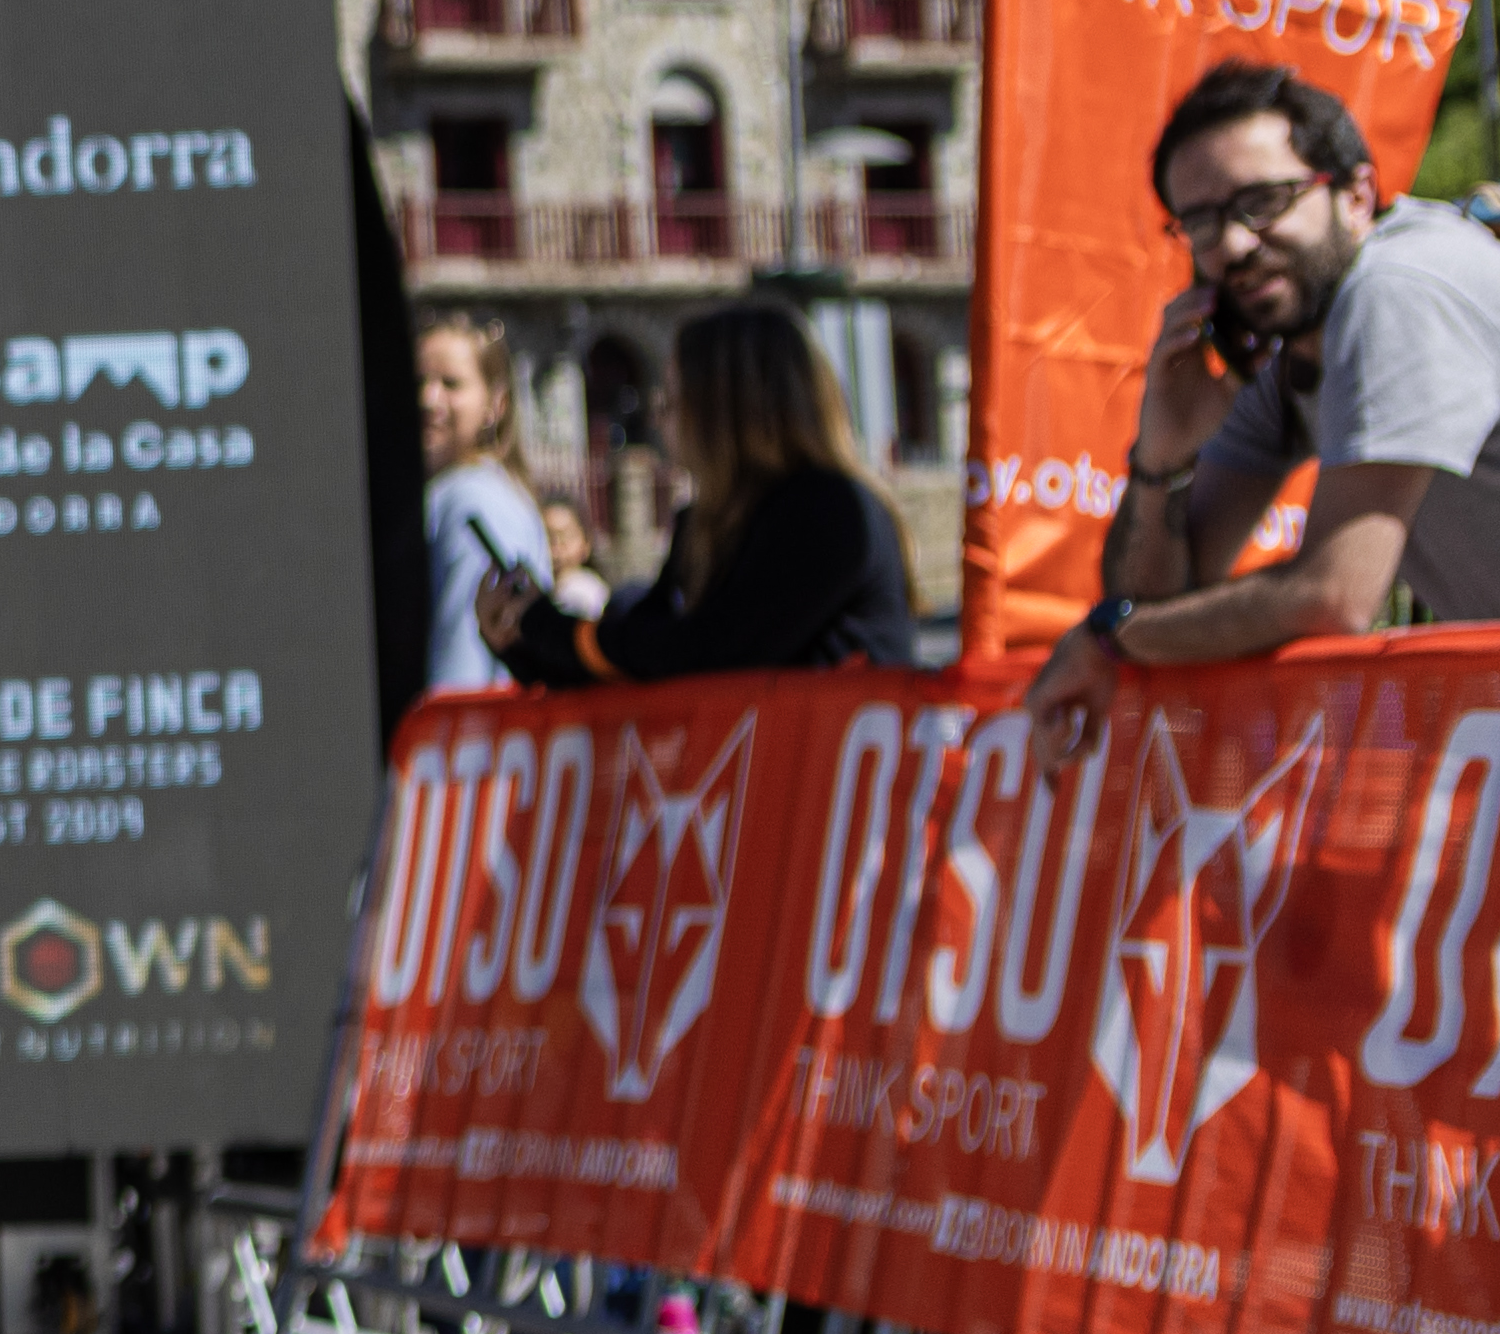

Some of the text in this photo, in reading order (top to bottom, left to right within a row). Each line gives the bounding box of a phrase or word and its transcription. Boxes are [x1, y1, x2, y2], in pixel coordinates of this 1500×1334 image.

[64, 424, 113, 473] la
[123, 422, 255, 470] Casa
[88, 670, 264, 735] FINCA
[27, 742, 222, 790] ROASTERS
[373, 726, 597, 1006] OTSO
[807, 702, 1109, 1044] OTSO
[792, 1045, 1048, 1161] THINK SPORT
[1360, 1129, 1500, 1241] THINK
[986, 1200, 1058, 1267] BORN
[1059, 1219, 1089, 1274] IN
[1088, 1227, 1221, 1304] ANDORRA
